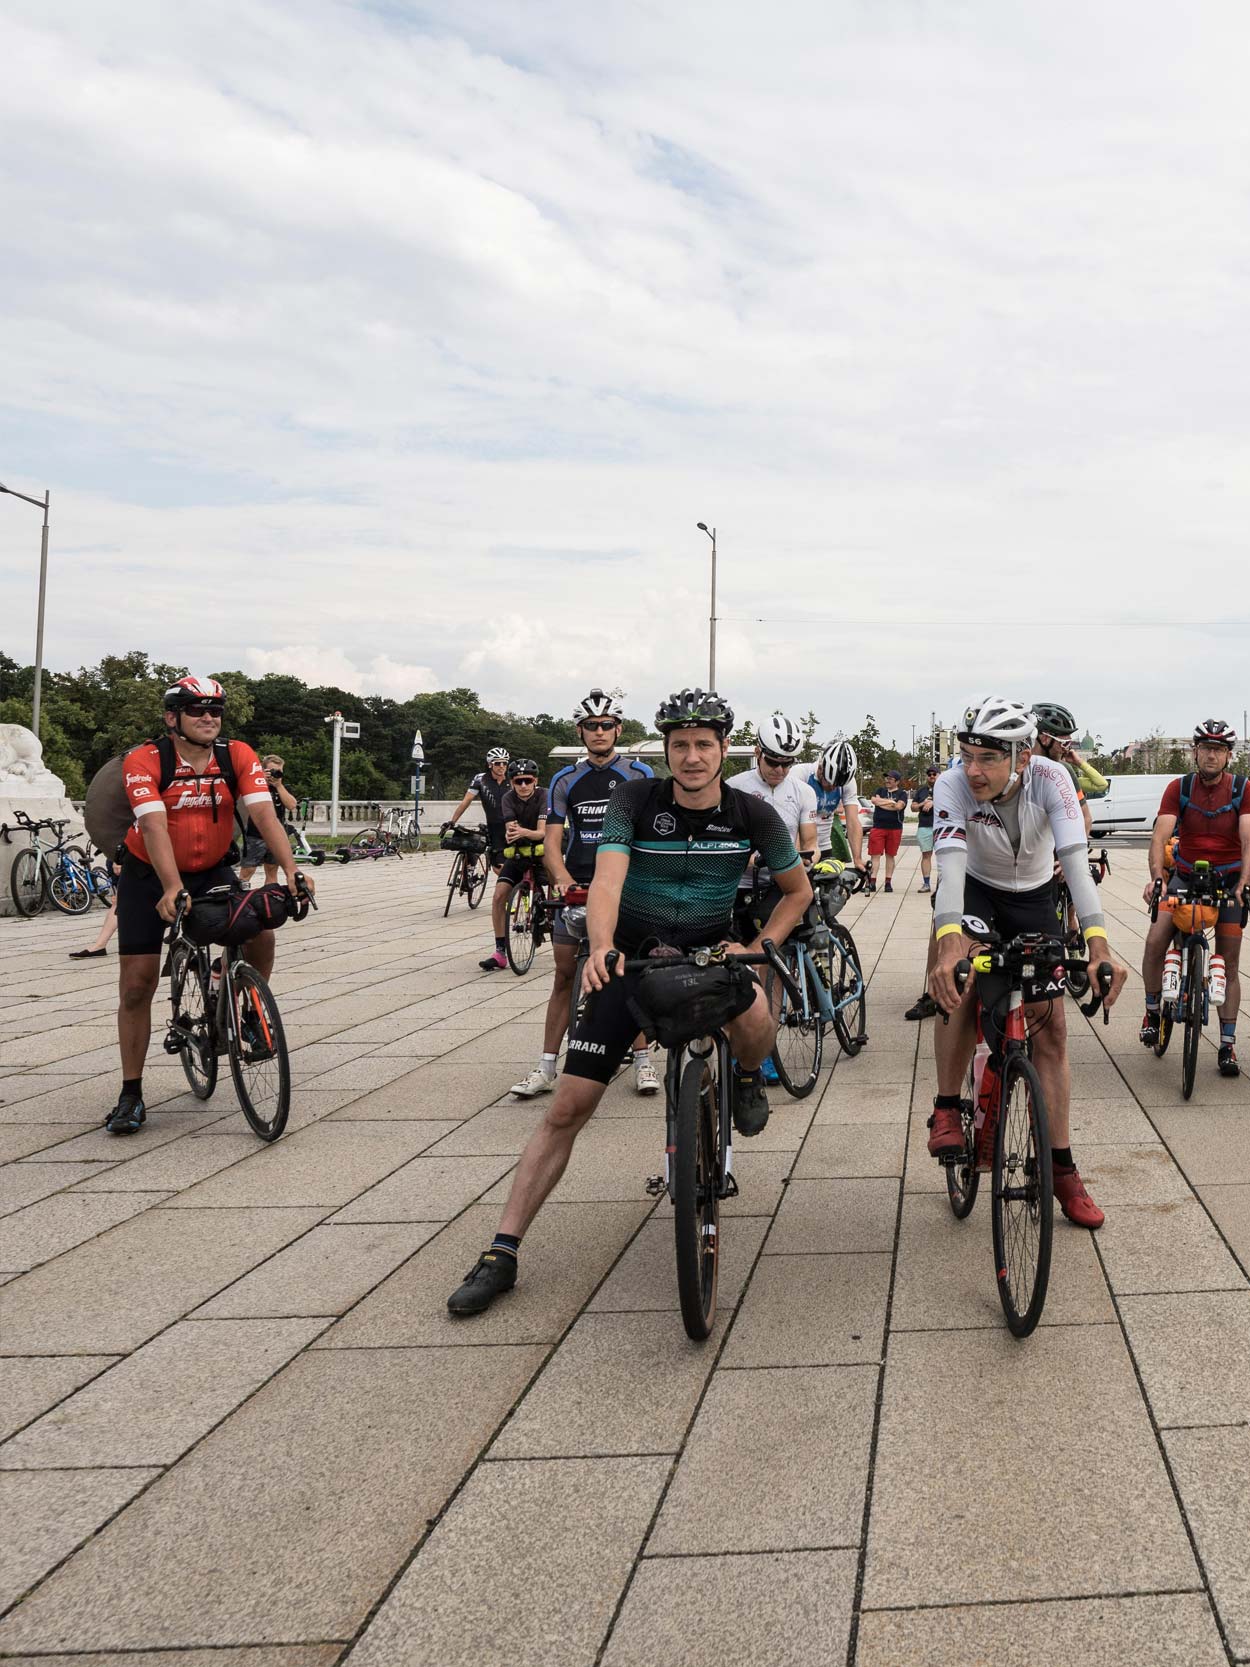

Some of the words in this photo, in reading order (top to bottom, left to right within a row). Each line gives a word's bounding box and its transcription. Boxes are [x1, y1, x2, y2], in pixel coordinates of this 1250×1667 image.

[968, 736, 983, 746] 56
[1032, 764, 1078, 821] PACTIMO
[705, 823, 733, 833] Santini
